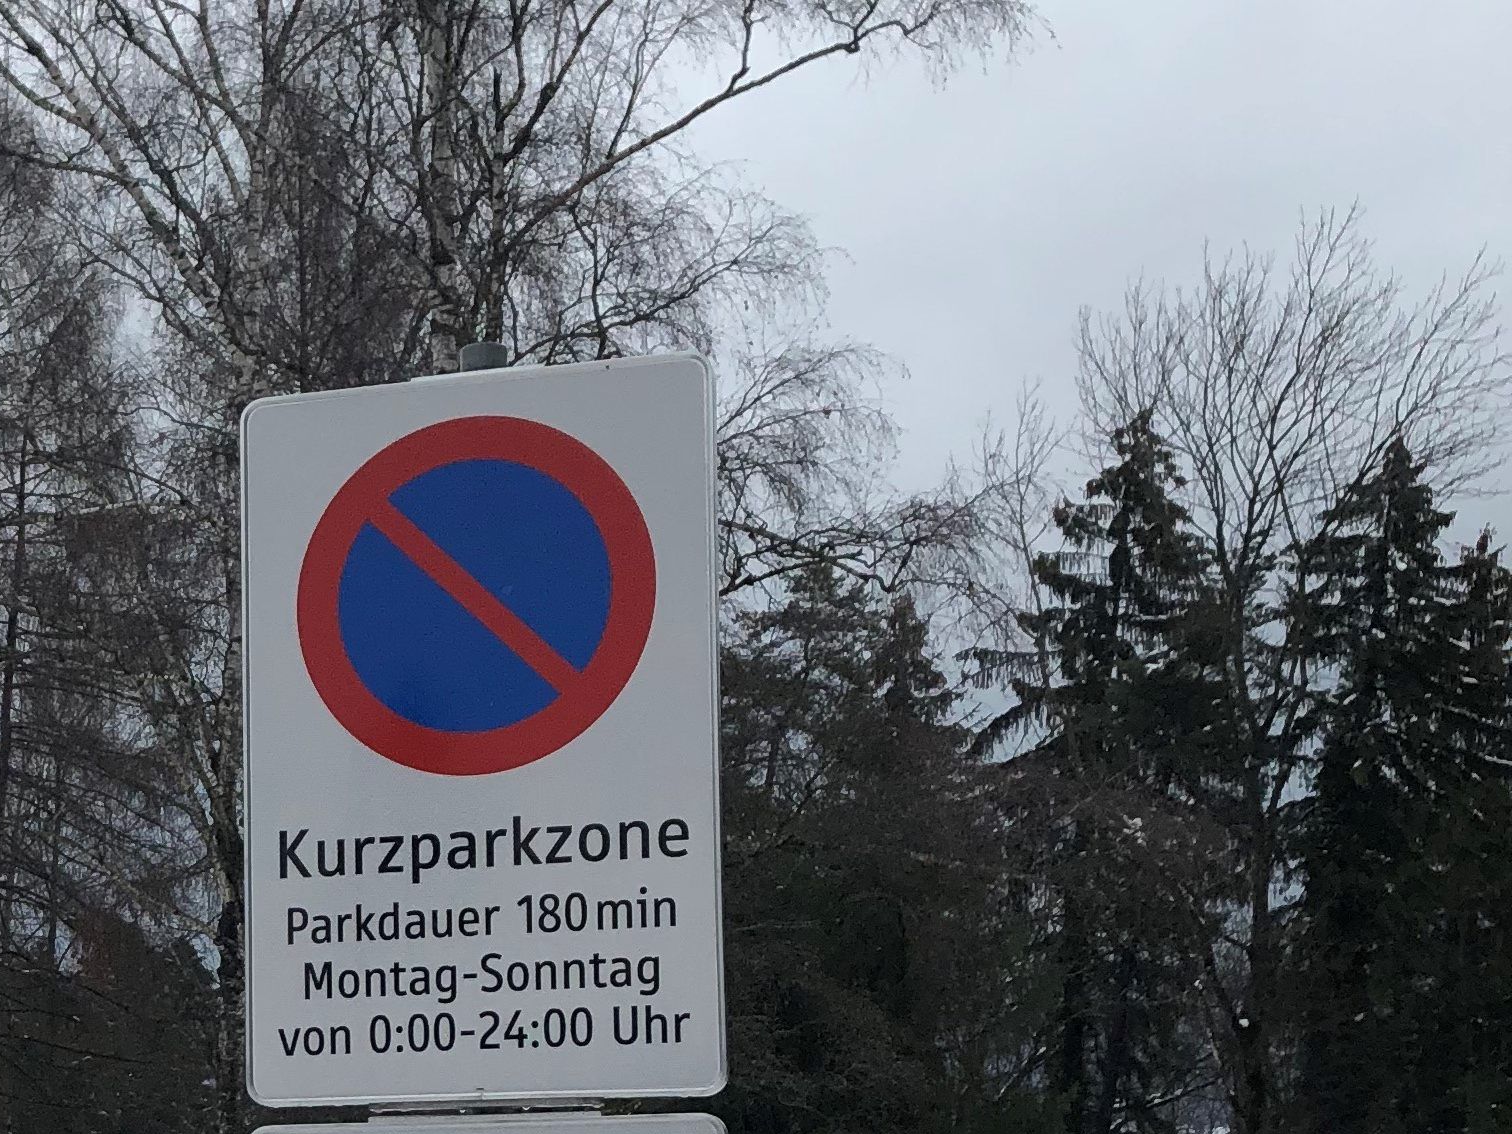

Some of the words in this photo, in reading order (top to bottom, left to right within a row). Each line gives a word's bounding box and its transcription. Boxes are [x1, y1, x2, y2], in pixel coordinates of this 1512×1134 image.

[278, 815, 690, 885] Kurzparkzone
[287, 901, 501, 946] Parkdauer
[304, 952, 660, 1005] Montag-Sonntag
[277, 1025, 351, 1057] von
[369, 1006, 593, 1054] 0:00-24:00
[612, 1004, 691, 1046] Uhr
